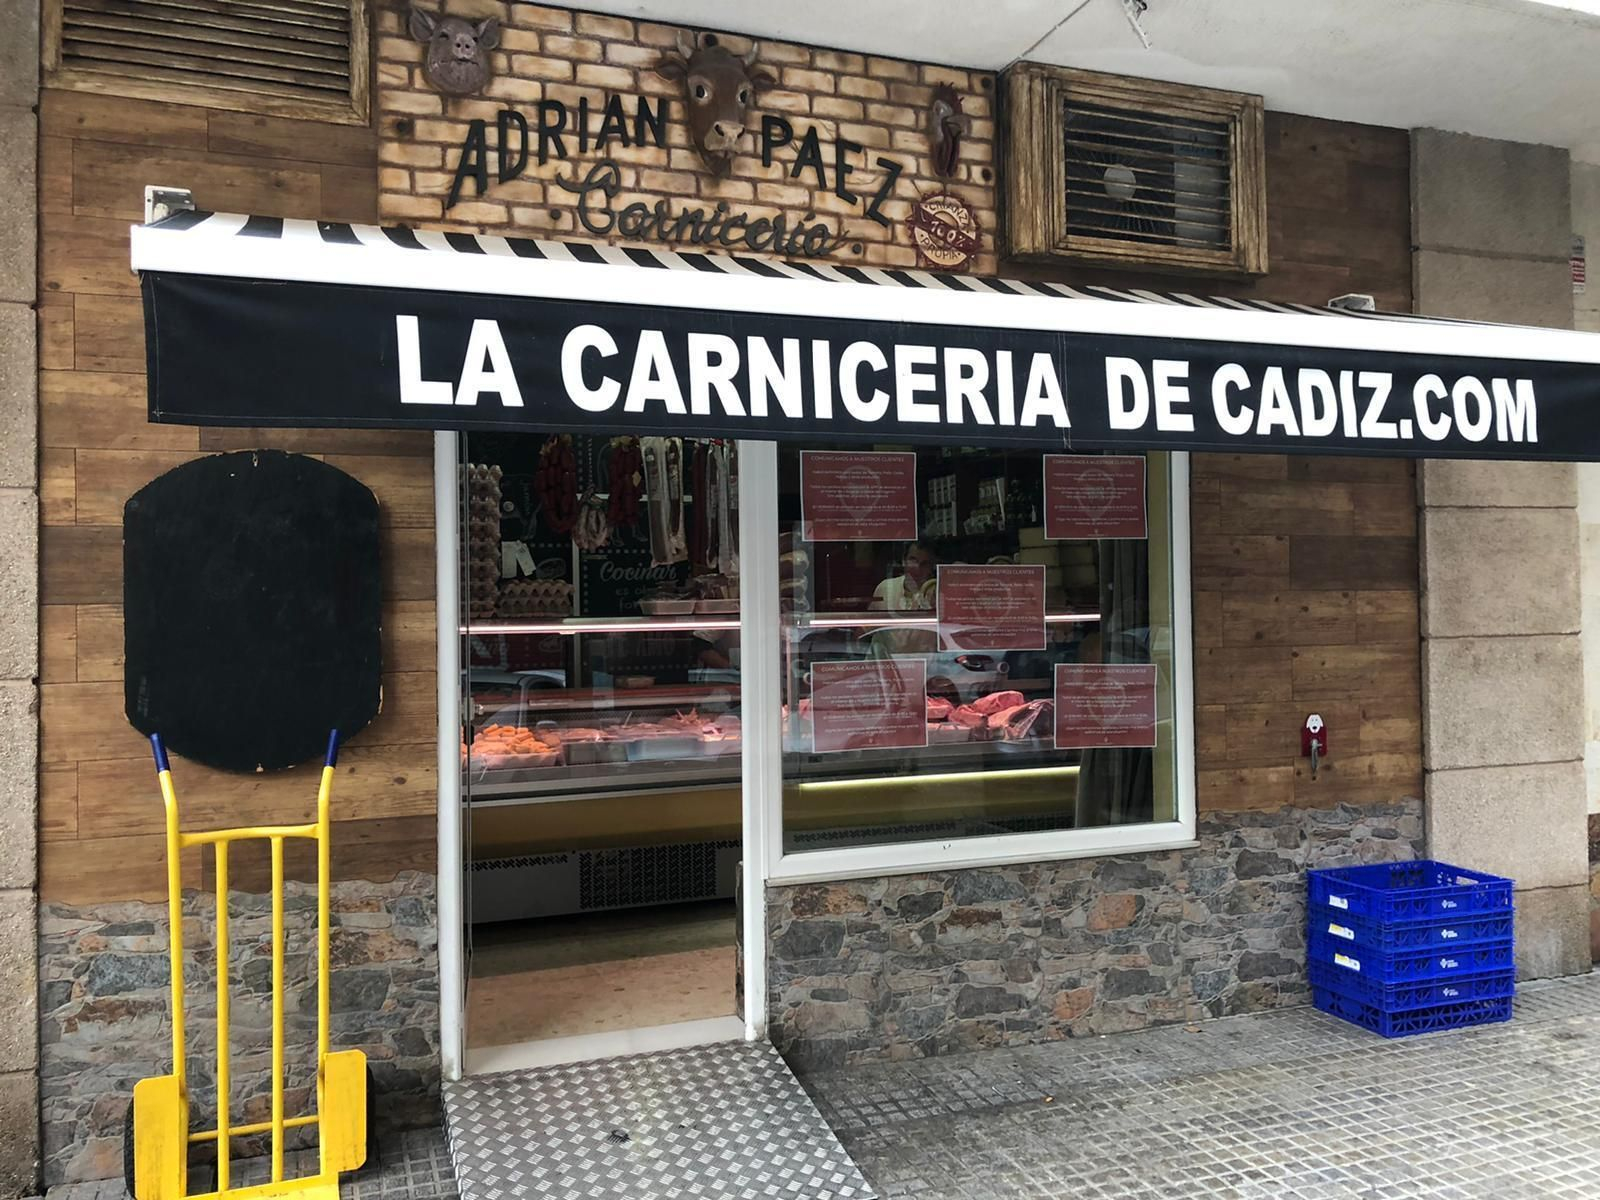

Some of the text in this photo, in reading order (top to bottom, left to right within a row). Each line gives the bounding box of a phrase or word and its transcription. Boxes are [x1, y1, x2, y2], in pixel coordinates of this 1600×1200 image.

[445, 94, 905, 227] ADRIAN PAEZ
[920, 237, 958, 260] PROPIA
[395, 314, 1539, 443] LA CARNICERIA DE CADIZ.COM
[599, 560, 680, 582] Cocinar
